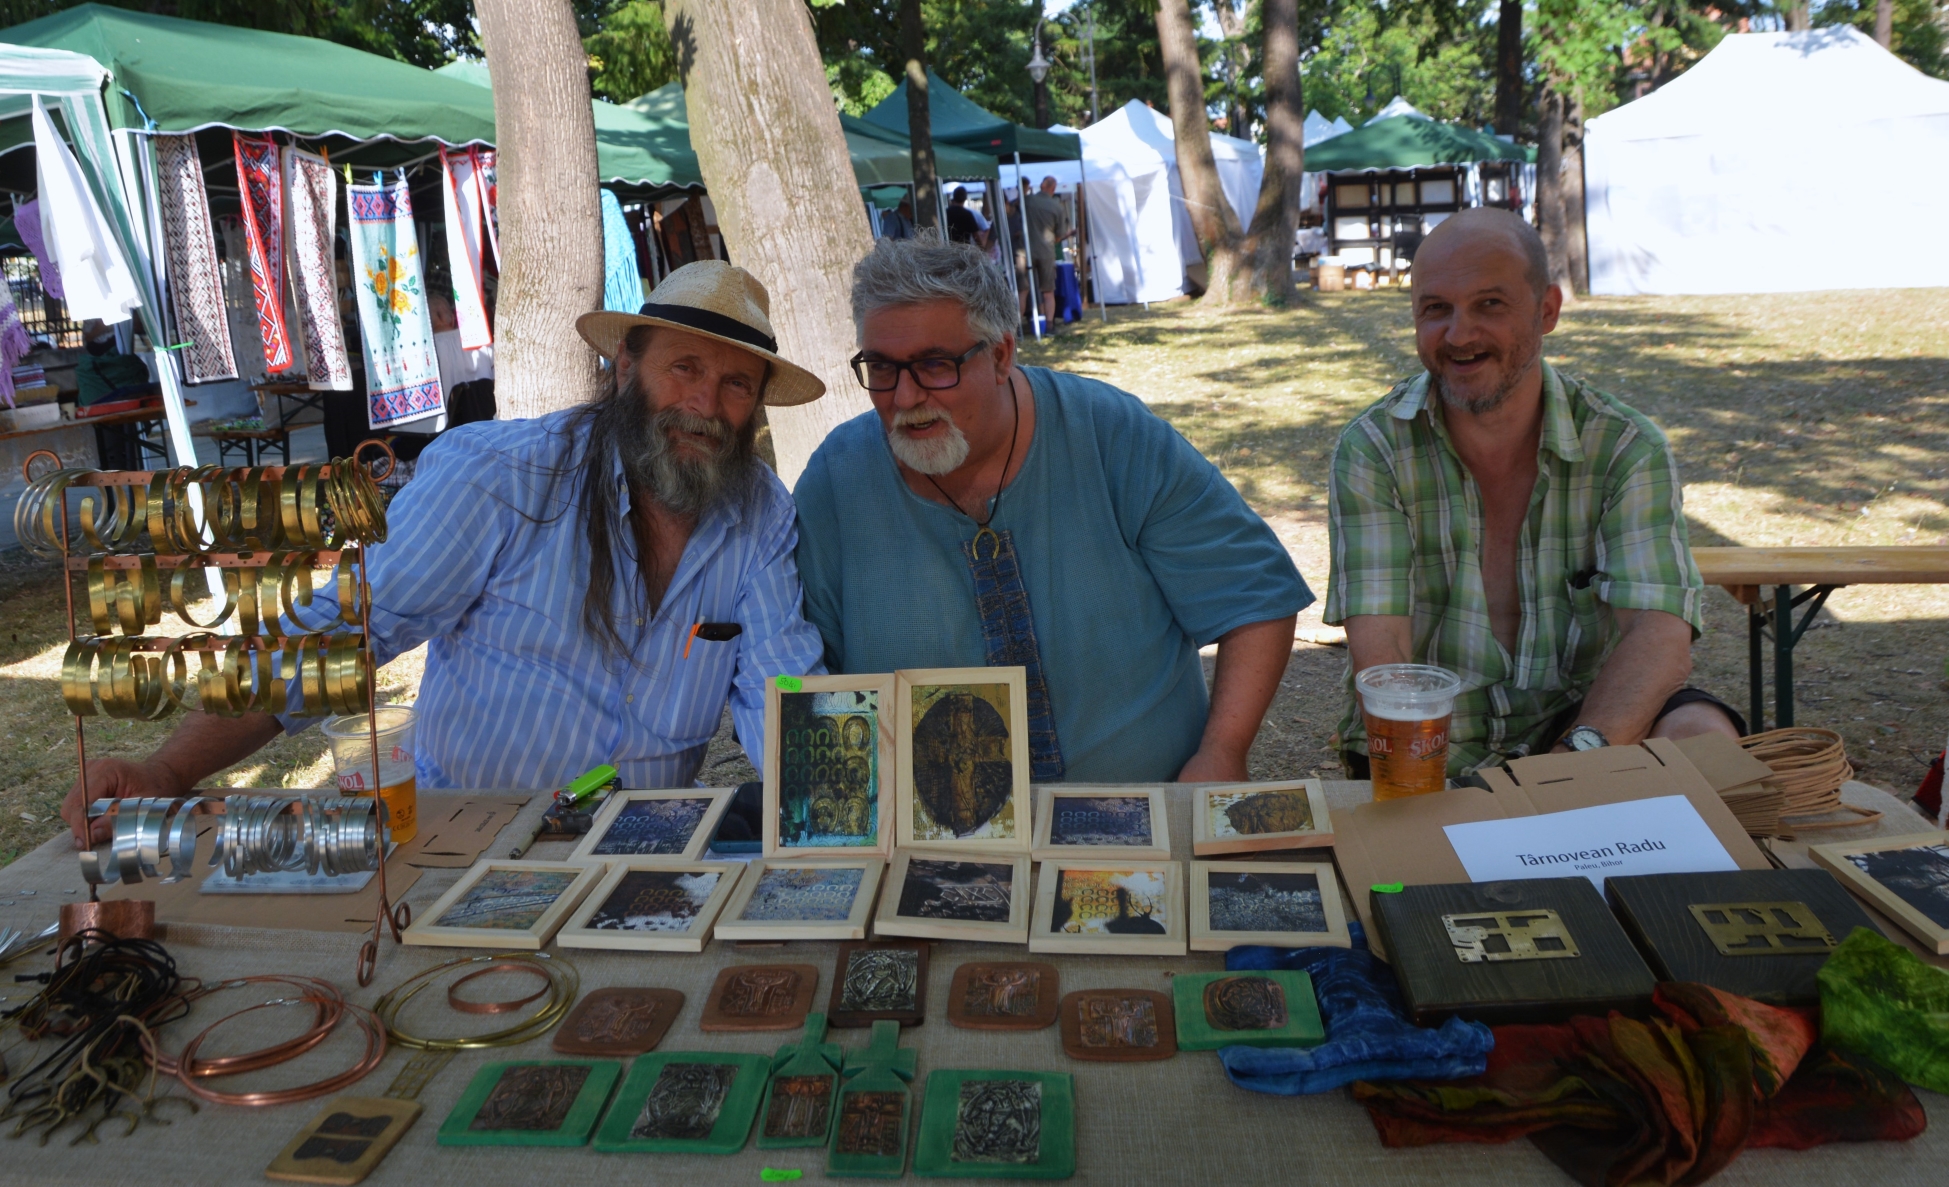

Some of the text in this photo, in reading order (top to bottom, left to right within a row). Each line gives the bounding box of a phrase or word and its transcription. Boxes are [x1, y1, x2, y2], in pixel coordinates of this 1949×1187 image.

[1369, 738, 1392, 753] KOL
[1410, 732, 1447, 759] SKOL
[338, 775, 363, 790] KOL
[1515, 838, 1667, 867] Târnovean Radu
[1574, 859, 1623, 871] Paleu, Bihor
